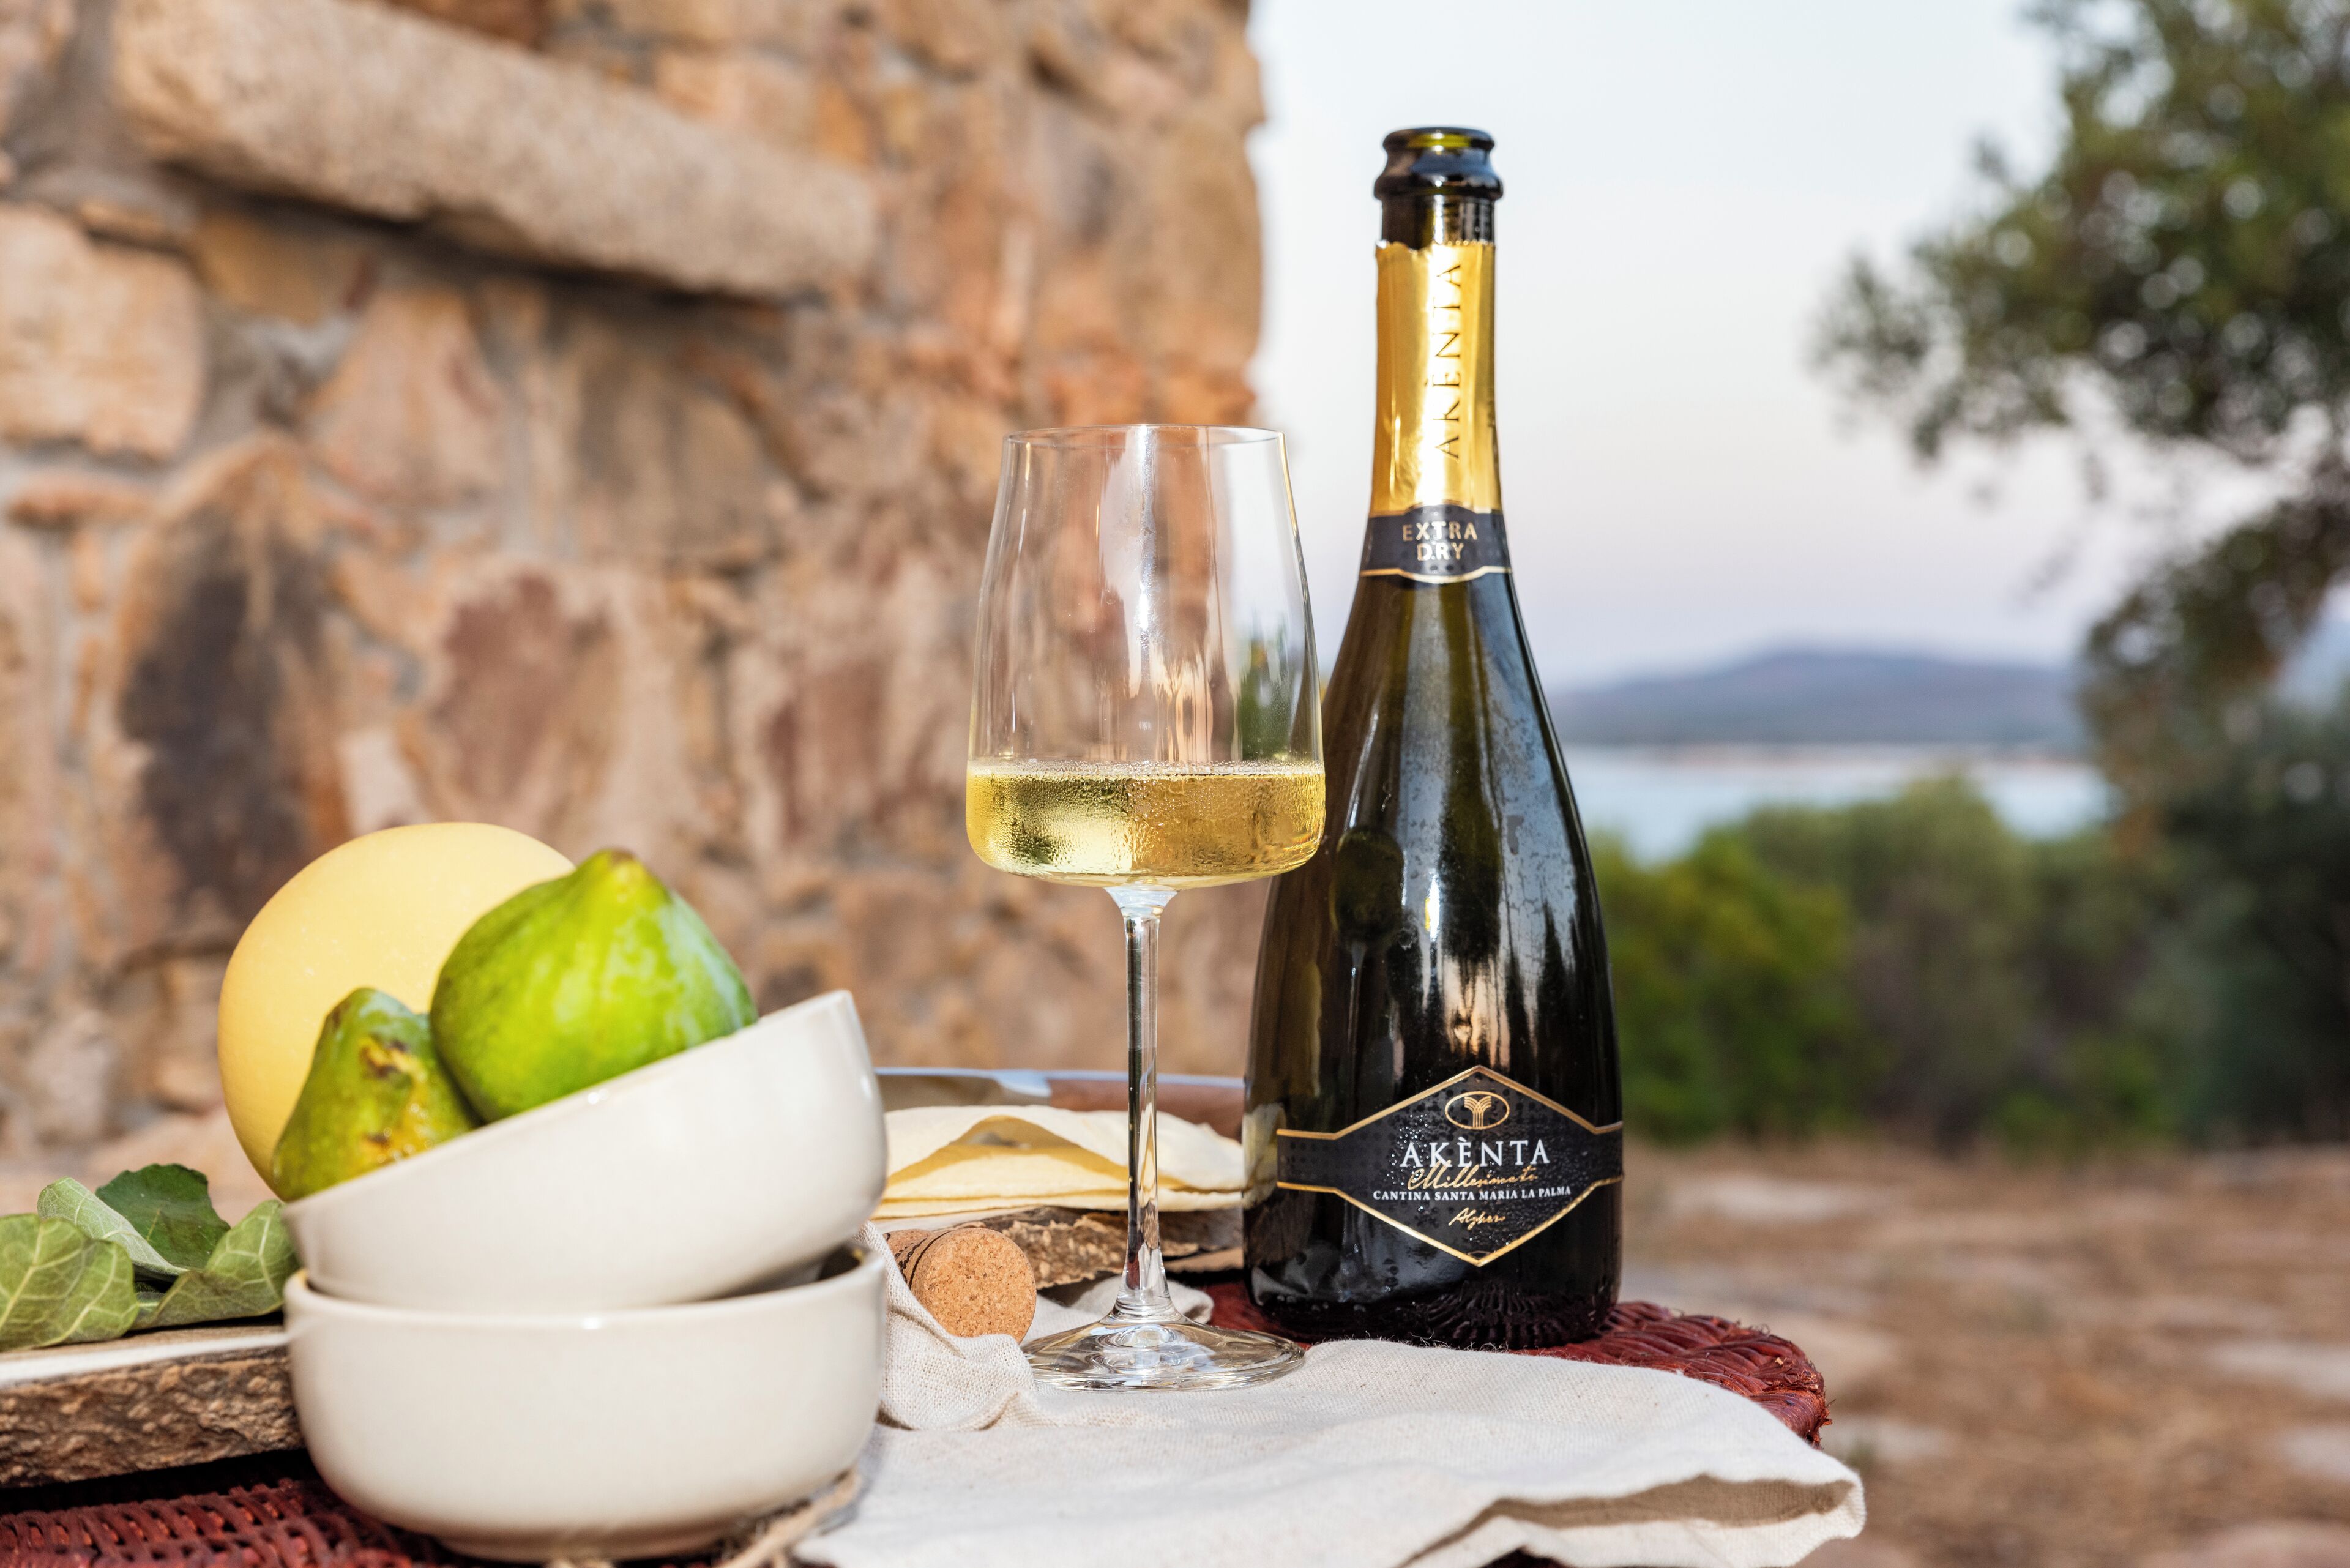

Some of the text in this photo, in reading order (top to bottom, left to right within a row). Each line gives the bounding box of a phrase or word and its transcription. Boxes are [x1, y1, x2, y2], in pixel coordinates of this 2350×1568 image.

[1402, 521, 1478, 542] EXTRA
[1417, 542, 1464, 561] DRY
[1399, 1137, 1551, 1167] AKÈNTA
[1373, 1185, 1572, 1201] CANTINA SANTA MARIA LA PALMA
